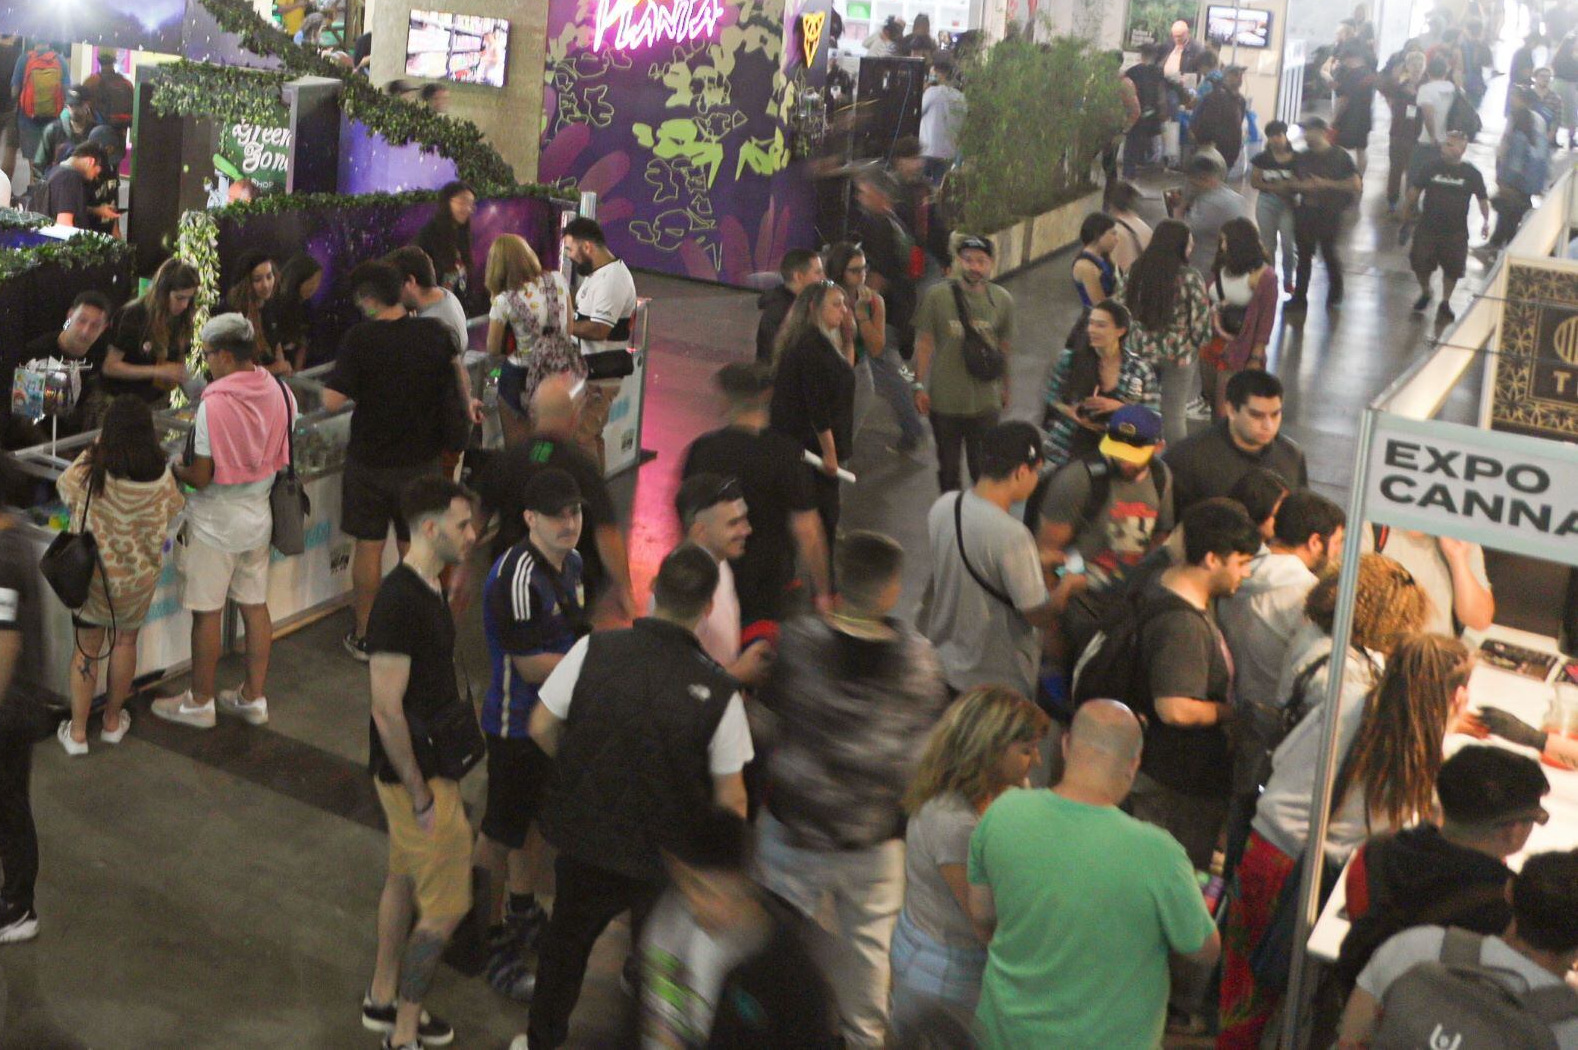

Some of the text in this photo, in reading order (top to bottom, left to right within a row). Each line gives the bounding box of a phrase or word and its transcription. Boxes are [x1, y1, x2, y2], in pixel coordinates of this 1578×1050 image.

[242, 141, 289, 173] Zon
[1384, 438, 1551, 494] EXPO
[1379, 474, 1578, 536] CANNA
